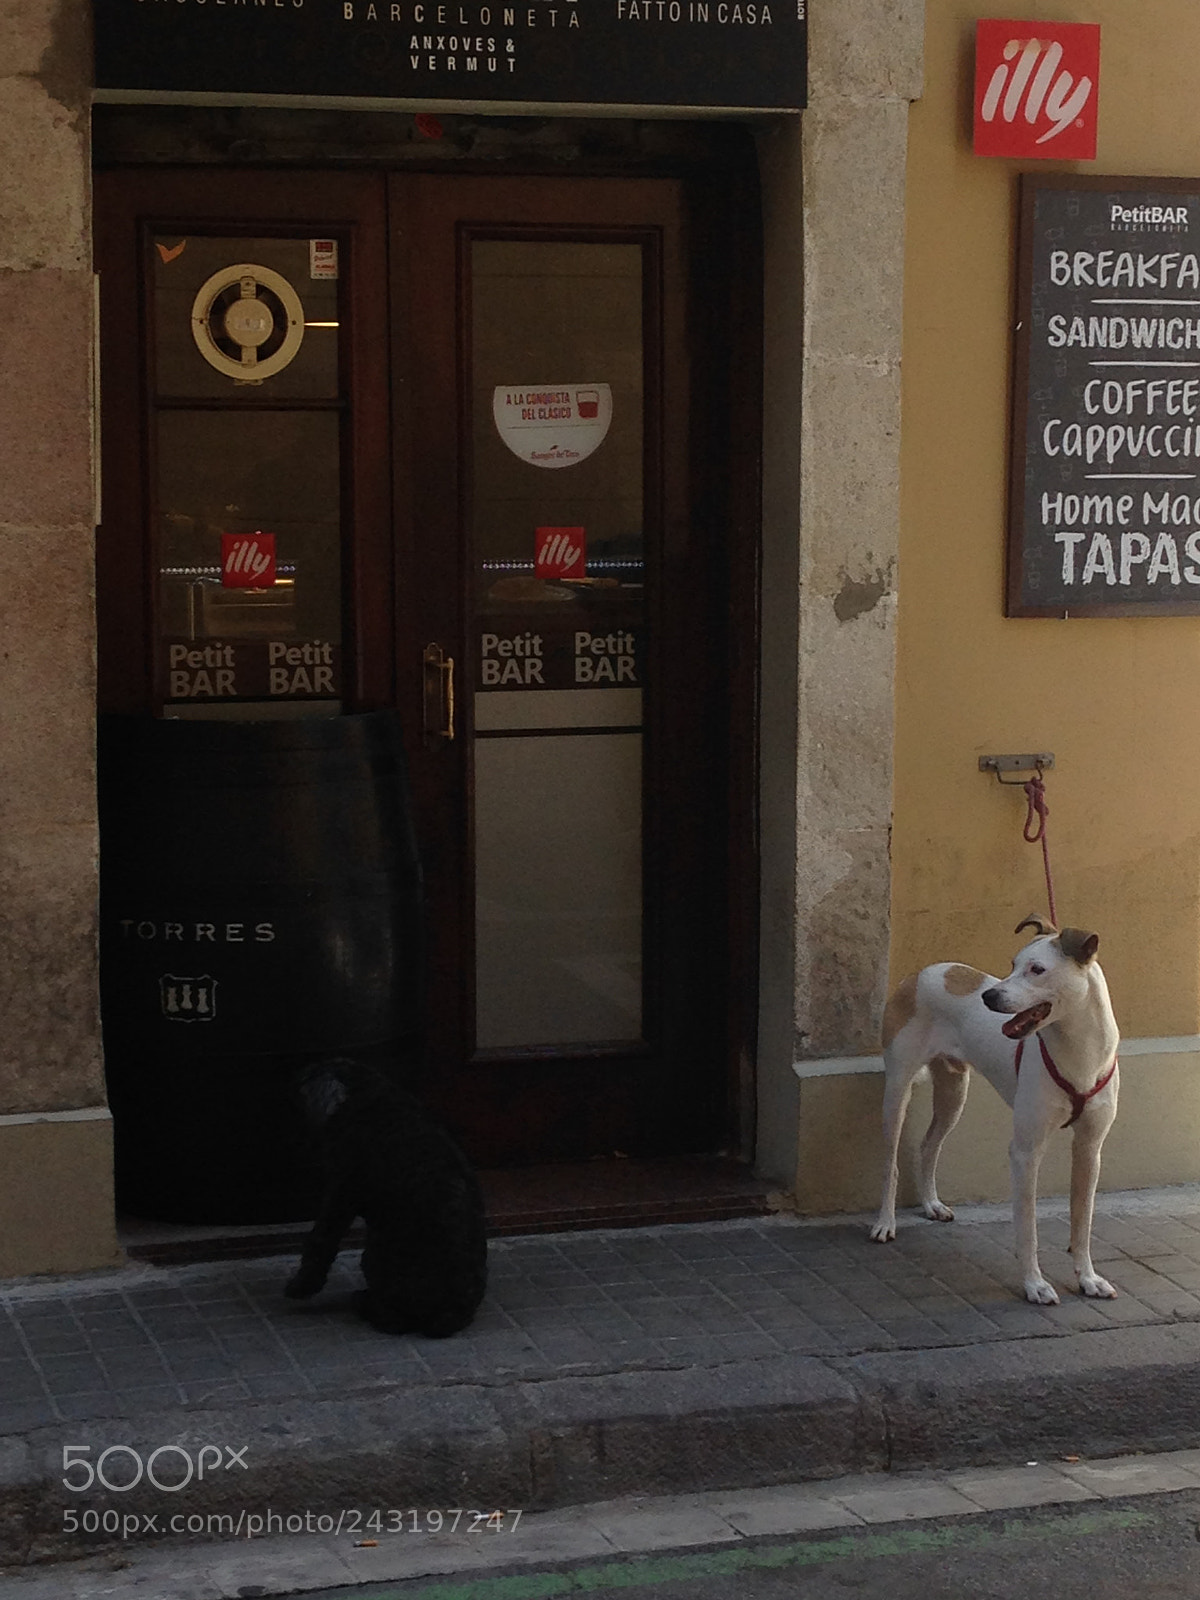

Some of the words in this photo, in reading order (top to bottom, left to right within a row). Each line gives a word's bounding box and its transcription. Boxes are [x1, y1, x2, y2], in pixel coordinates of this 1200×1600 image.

[343, 3, 580, 28] BARCELONETA
[617, 0, 681, 22] FATTO
[689, 2, 709, 23] IN
[717, 2, 773, 25] CASA
[410, 35, 496, 52] ANXOVES
[505, 38, 515, 52] &
[410, 56, 516, 72] VERMUT
[981, 38, 1093, 144] illy
[1111, 205, 1189, 224] PetitBAR
[1084, 379, 1200, 416] COFFEE
[1043, 418, 1200, 464] Cappucci
[1041, 492, 1134, 525] Home
[225, 540, 272, 581] illy
[537, 533, 582, 572] illy
[169, 642, 236, 669] Petit
[268, 639, 334, 666] Petit
[481, 631, 543, 657] Petit
[574, 630, 635, 655] Petit
[269, 666, 336, 695] BAR
[481, 657, 545, 685] BAR
[574, 655, 637, 683] BAR
[170, 670, 238, 698] BAR
[120, 919, 276, 942] TORRES
